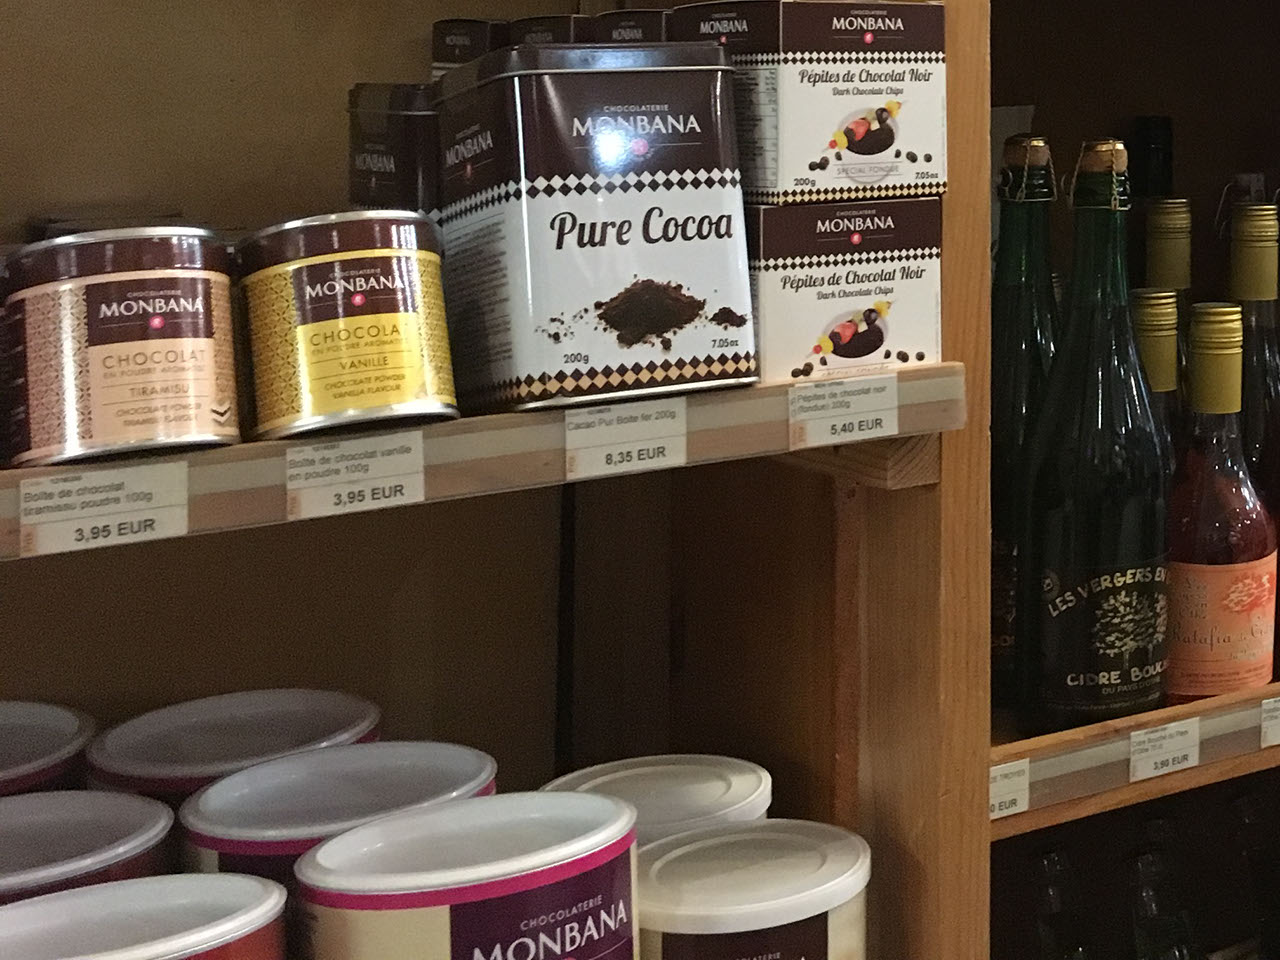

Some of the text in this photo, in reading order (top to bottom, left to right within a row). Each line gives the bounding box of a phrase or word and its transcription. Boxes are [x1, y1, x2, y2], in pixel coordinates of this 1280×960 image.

[700, 19, 748, 34] MONBANA
[832, 16, 904, 31] MONBANA
[799, 68, 934, 87] Pépites de Chocolat Noir
[572, 115, 701, 137] MONBANA
[445, 130, 493, 167] MONBANA
[355, 152, 395, 173] MONBANA
[793, 177, 816, 188] 200g
[550, 206, 733, 250] Pure Cocoa
[816, 216, 895, 234] MONBANA
[306, 275, 404, 299] MONBANA
[781, 265, 926, 293] Pépites de Chocolat Noir
[99, 297, 204, 319] MONBANA
[310, 324, 406, 347] CHOCOLA
[712, 338, 740, 349] 7.05oz
[102, 349, 205, 369] CHOCOLAT
[340, 356, 389, 370] VANILLE
[563, 353, 590, 364] 200g
[131, 383, 190, 397] TIRAMISU
[828, 391, 838, 399] de
[567, 420, 597, 431] Cacao
[598, 417, 614, 427] Pur
[655, 409, 677, 420] 200g
[830, 418, 883, 436] 5,40 EUR
[605, 446, 667, 467] 8,35 EUR
[344, 462, 370, 474] 100g
[333, 484, 405, 507] 3,95 EUR
[74, 518, 157, 543] 3,95 EUR
[1048, 590, 1077, 617] LES
[1078, 567, 1153, 599] VERGERS
[1066, 670, 1121, 687] CIDRE
[1172, 754, 1189, 766] EUR
[998, 798, 1018, 811] EUR
[520, 895, 603, 931] CHOCOLATERIE
[472, 899, 628, 960] MONBANA
